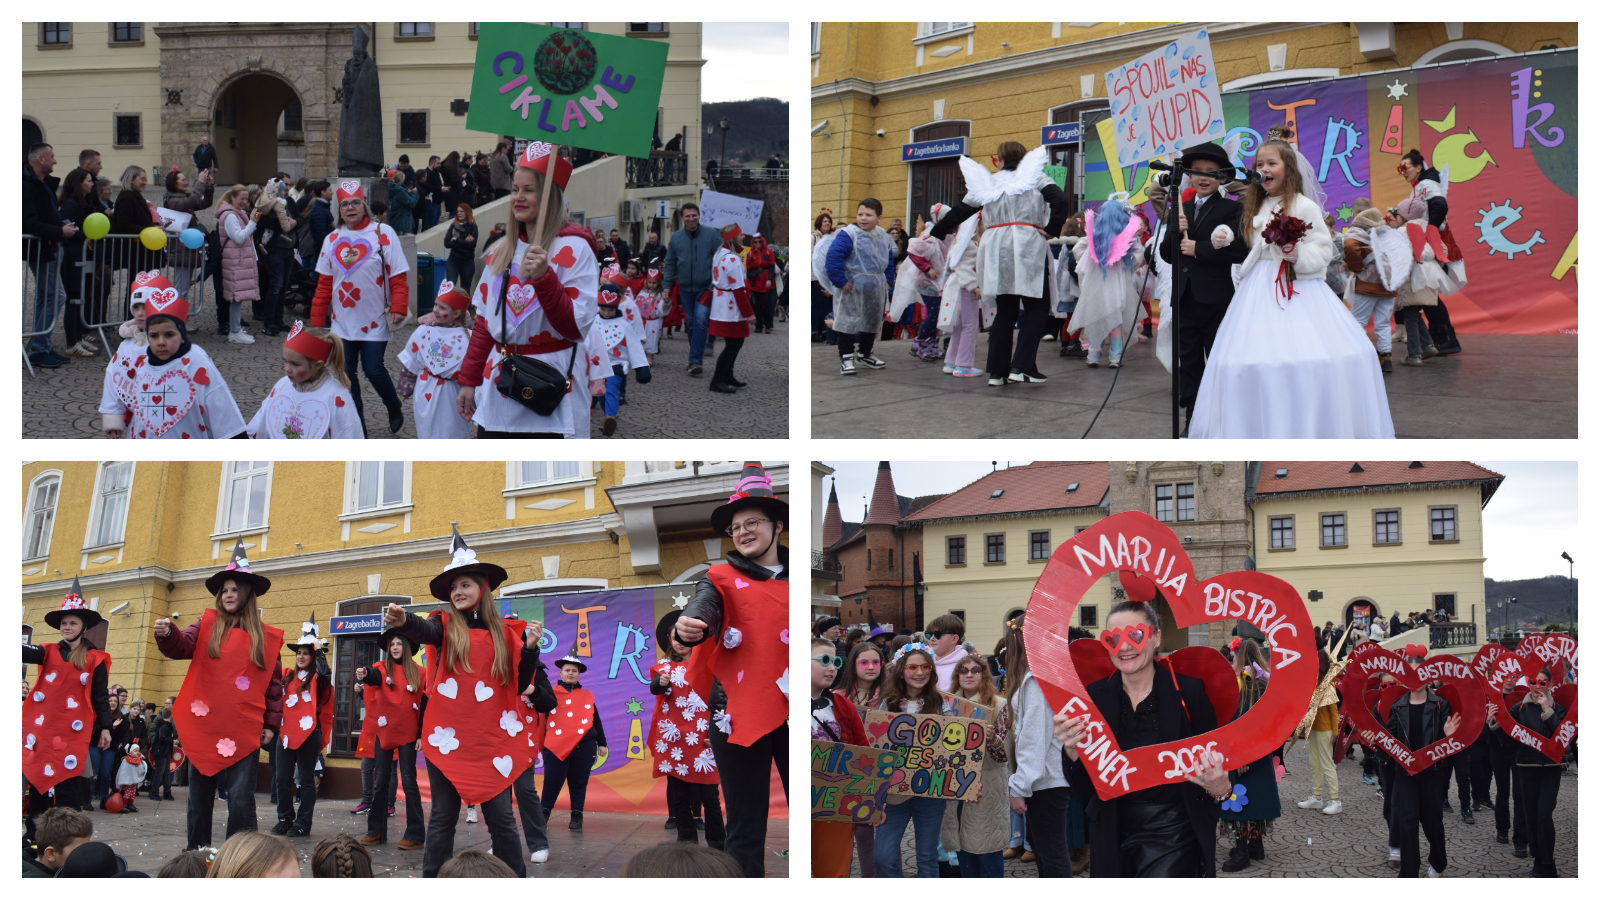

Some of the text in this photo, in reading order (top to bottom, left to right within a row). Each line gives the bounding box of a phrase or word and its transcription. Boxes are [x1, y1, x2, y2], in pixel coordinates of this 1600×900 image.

[493, 50, 636, 133] CIKLAME
[1114, 55, 1207, 114] SPOJIL NAS
[1057, 127, 1080, 140] Zagreb
[1126, 89, 1212, 149] JE KUPID
[913, 142, 960, 157] Zagrebačka banka
[1073, 532, 1301, 670] MARIJA BISTRICA
[344, 618, 381, 631] Zagrebačka
[1359, 656, 1474, 681] MARIJA BISTRICA
[886, 714, 984, 751] GOOD
[811, 743, 853, 775] MIR
[874, 743, 935, 769] BES
[1374, 731, 1466, 767] FAŠINEK 2026.
[842, 774, 875, 795] ZA
[911, 769, 977, 798] ONLY
